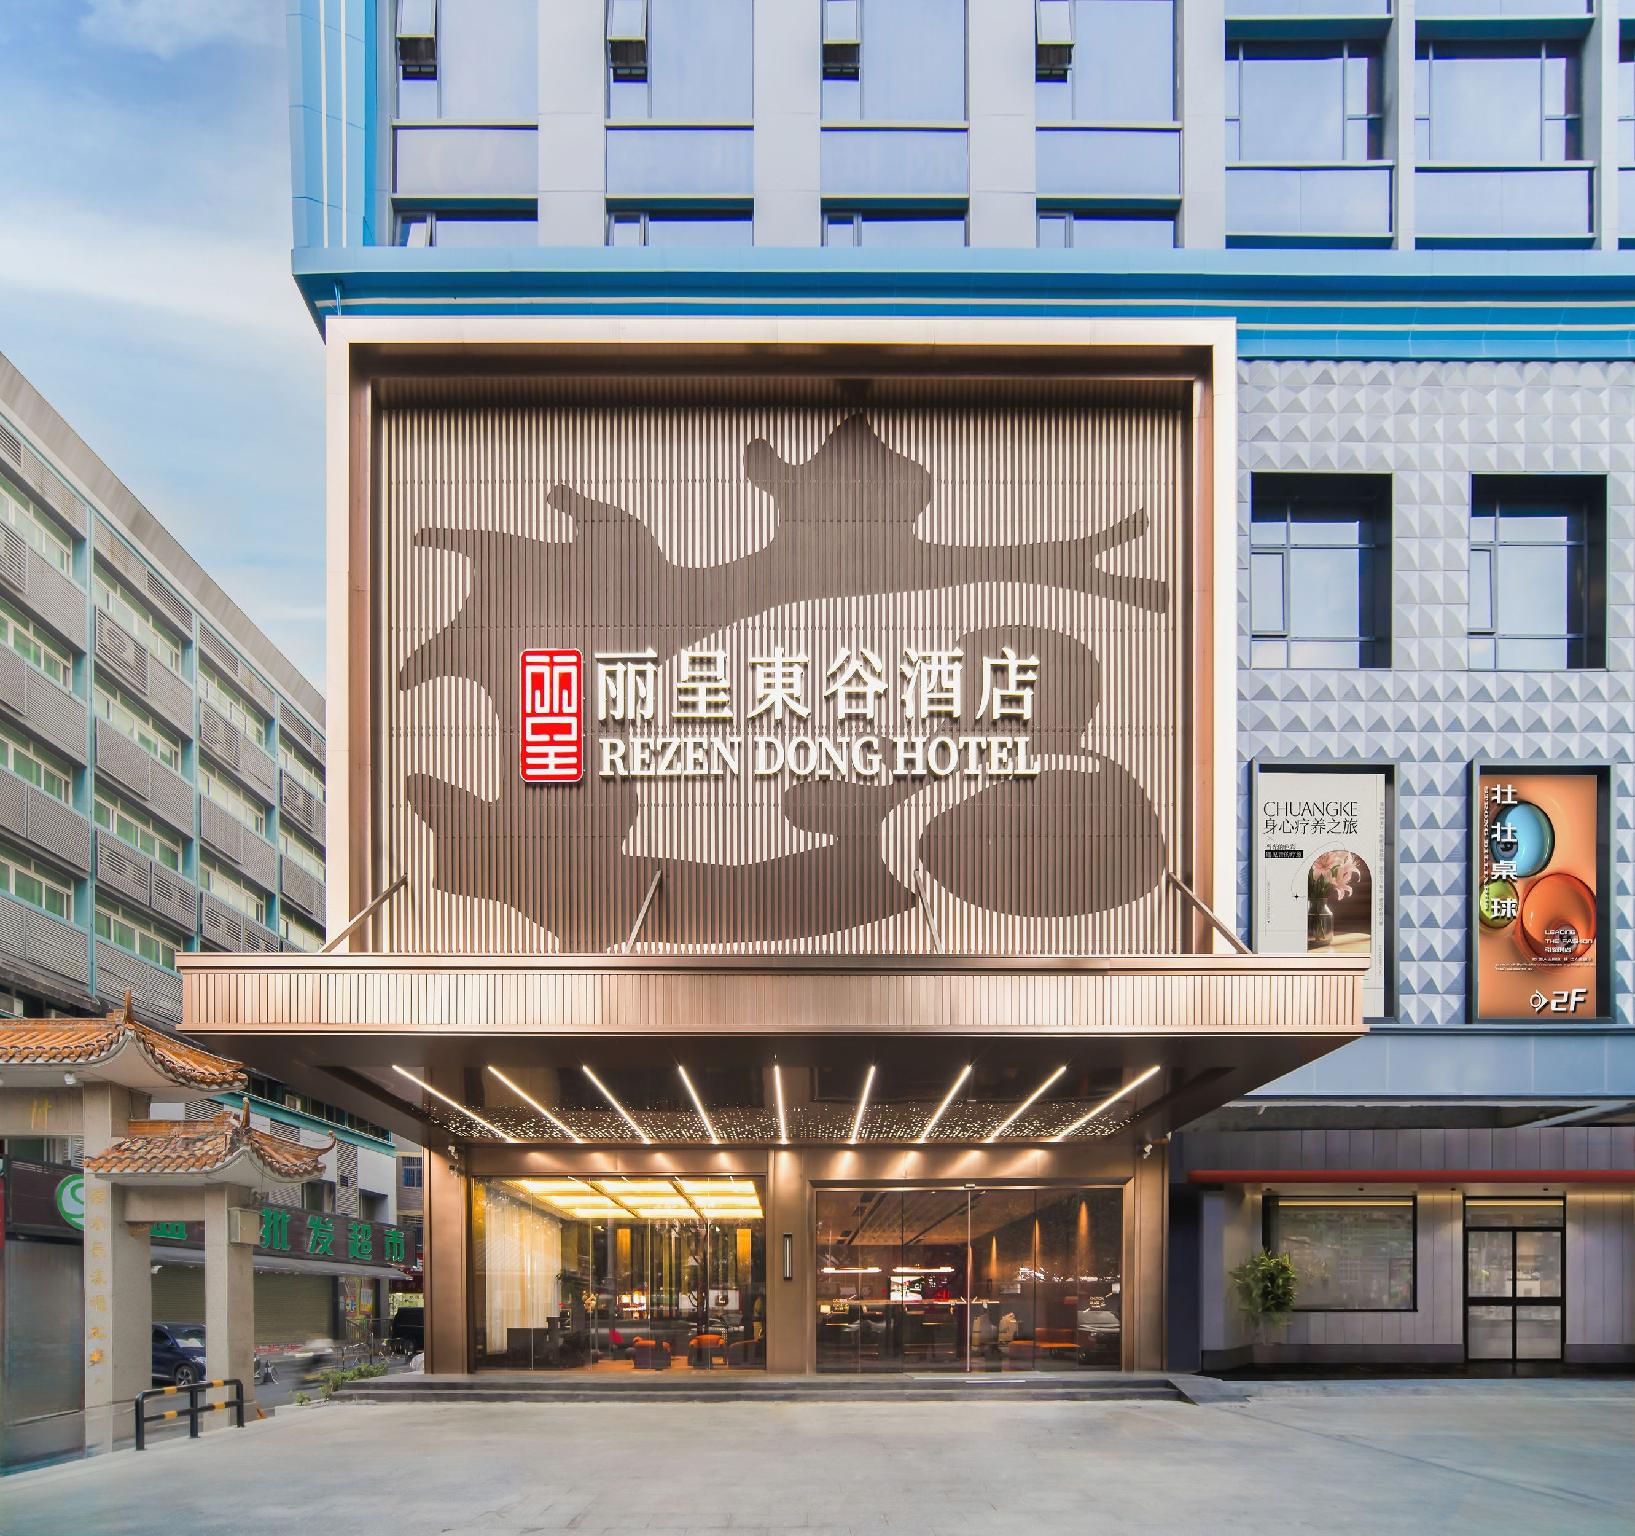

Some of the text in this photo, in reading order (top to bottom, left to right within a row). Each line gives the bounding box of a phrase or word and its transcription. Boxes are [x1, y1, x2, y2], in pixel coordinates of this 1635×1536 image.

[594, 647, 1041, 721] 丽呈東谷酒店
[598, 737, 1041, 777] REZEN DONG HOTEL
[1263, 801, 1358, 818] CHUANGKE
[1263, 818, 1358, 835] 身心疗养之旅
[1491, 784, 1518, 919] 壮壮桌球
[1550, 988, 1588, 1013] 2F
